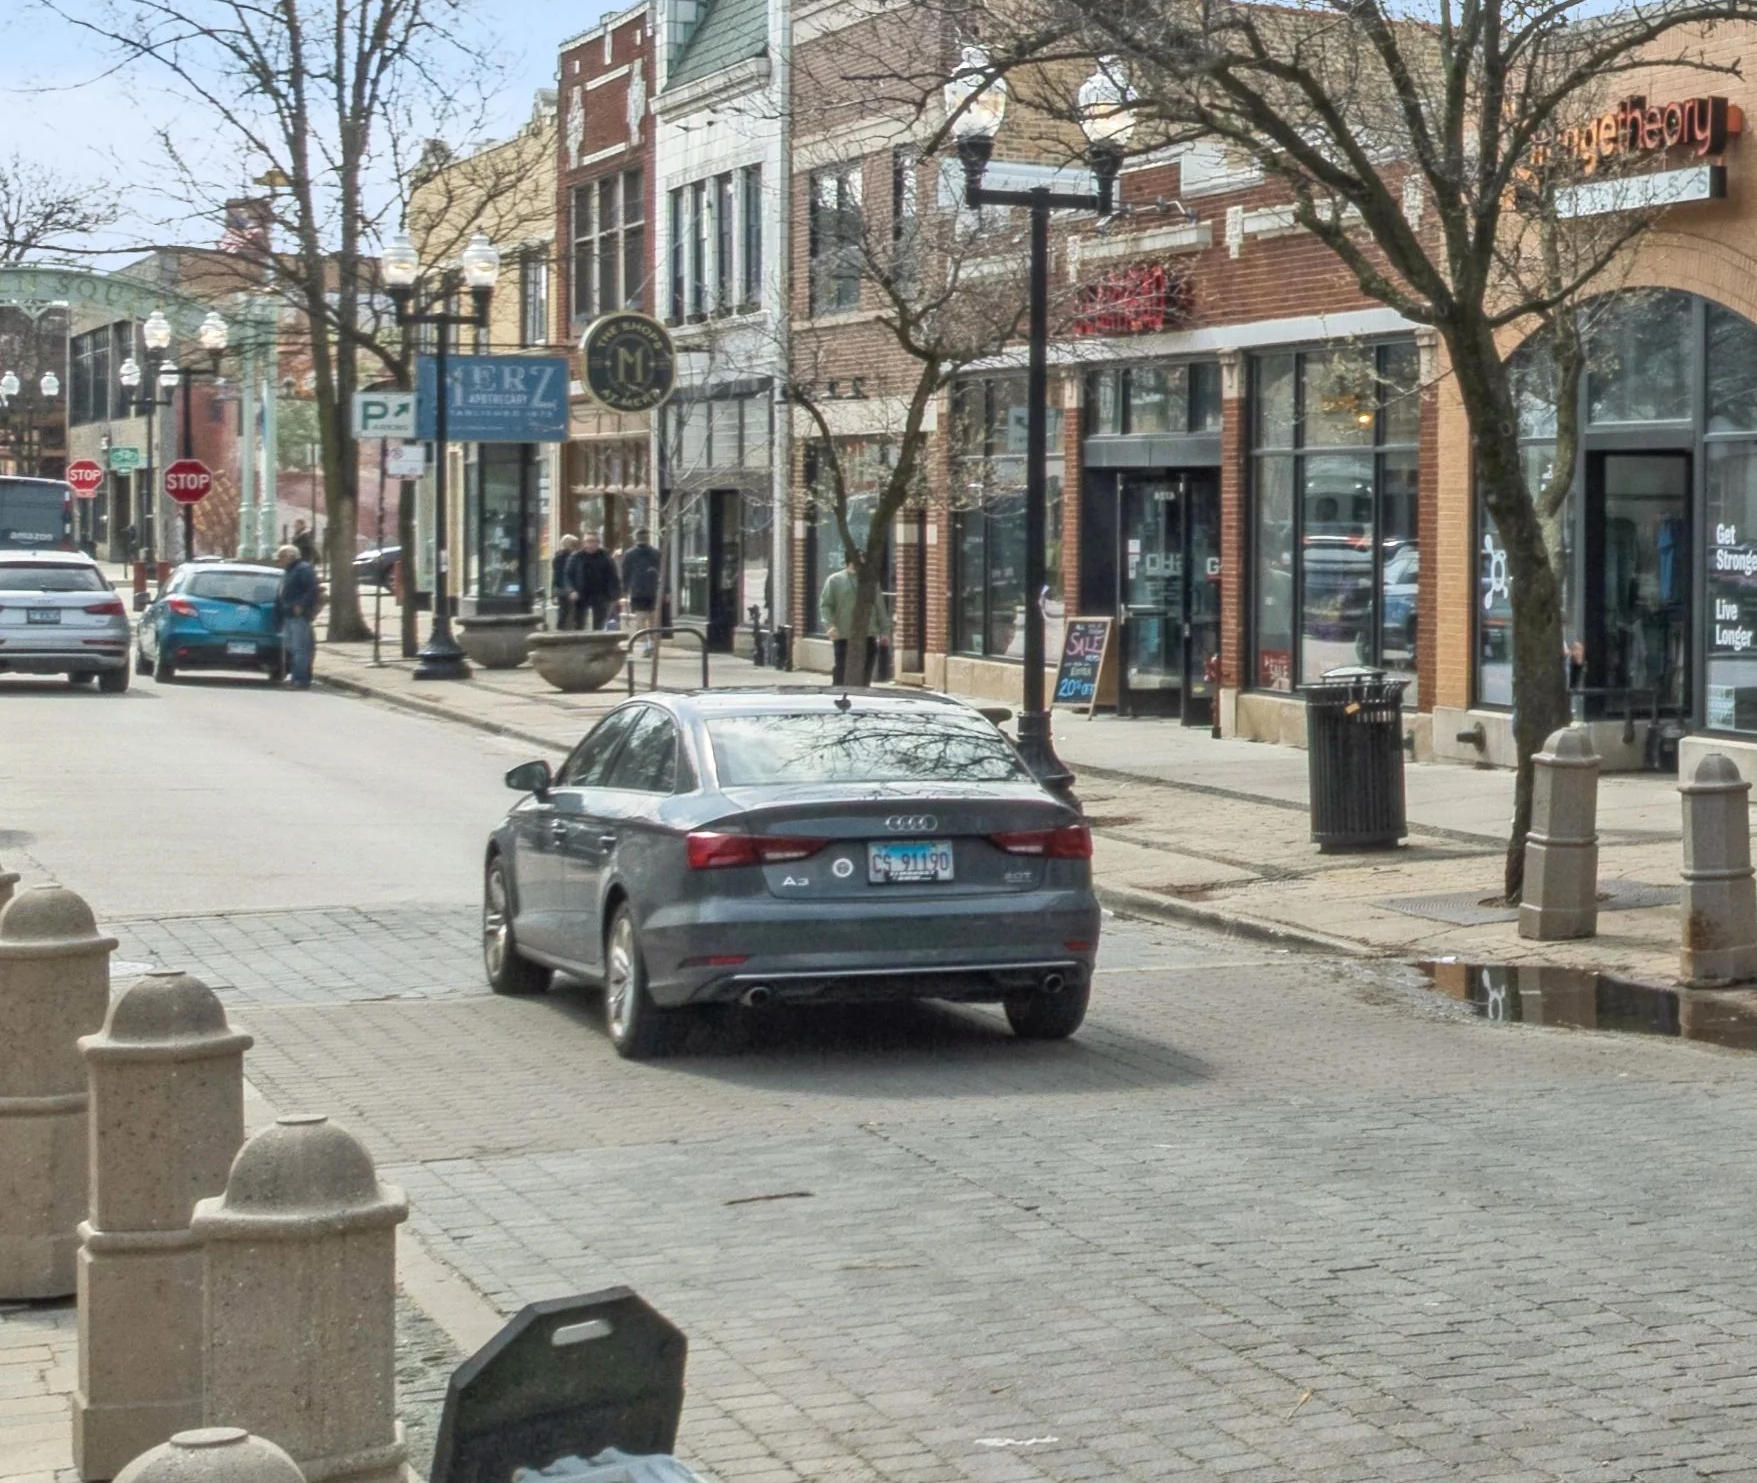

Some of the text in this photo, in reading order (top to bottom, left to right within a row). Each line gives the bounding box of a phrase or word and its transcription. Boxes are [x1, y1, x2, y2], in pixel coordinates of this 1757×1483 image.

[1526, 95, 1729, 177] ngetheory
[616, 347, 645, 383] M
[69, 468, 101, 481] STOP
[166, 472, 209, 490] STOP
[10, 531, 53, 542] amazon
[1715, 522, 1736, 546] Get
[1715, 598, 1738, 621] Live
[1066, 632, 1104, 656] SALE
[1715, 624, 1753, 651] Longer
[901, 851, 950, 872] 91190
[782, 875, 810, 886] A3
